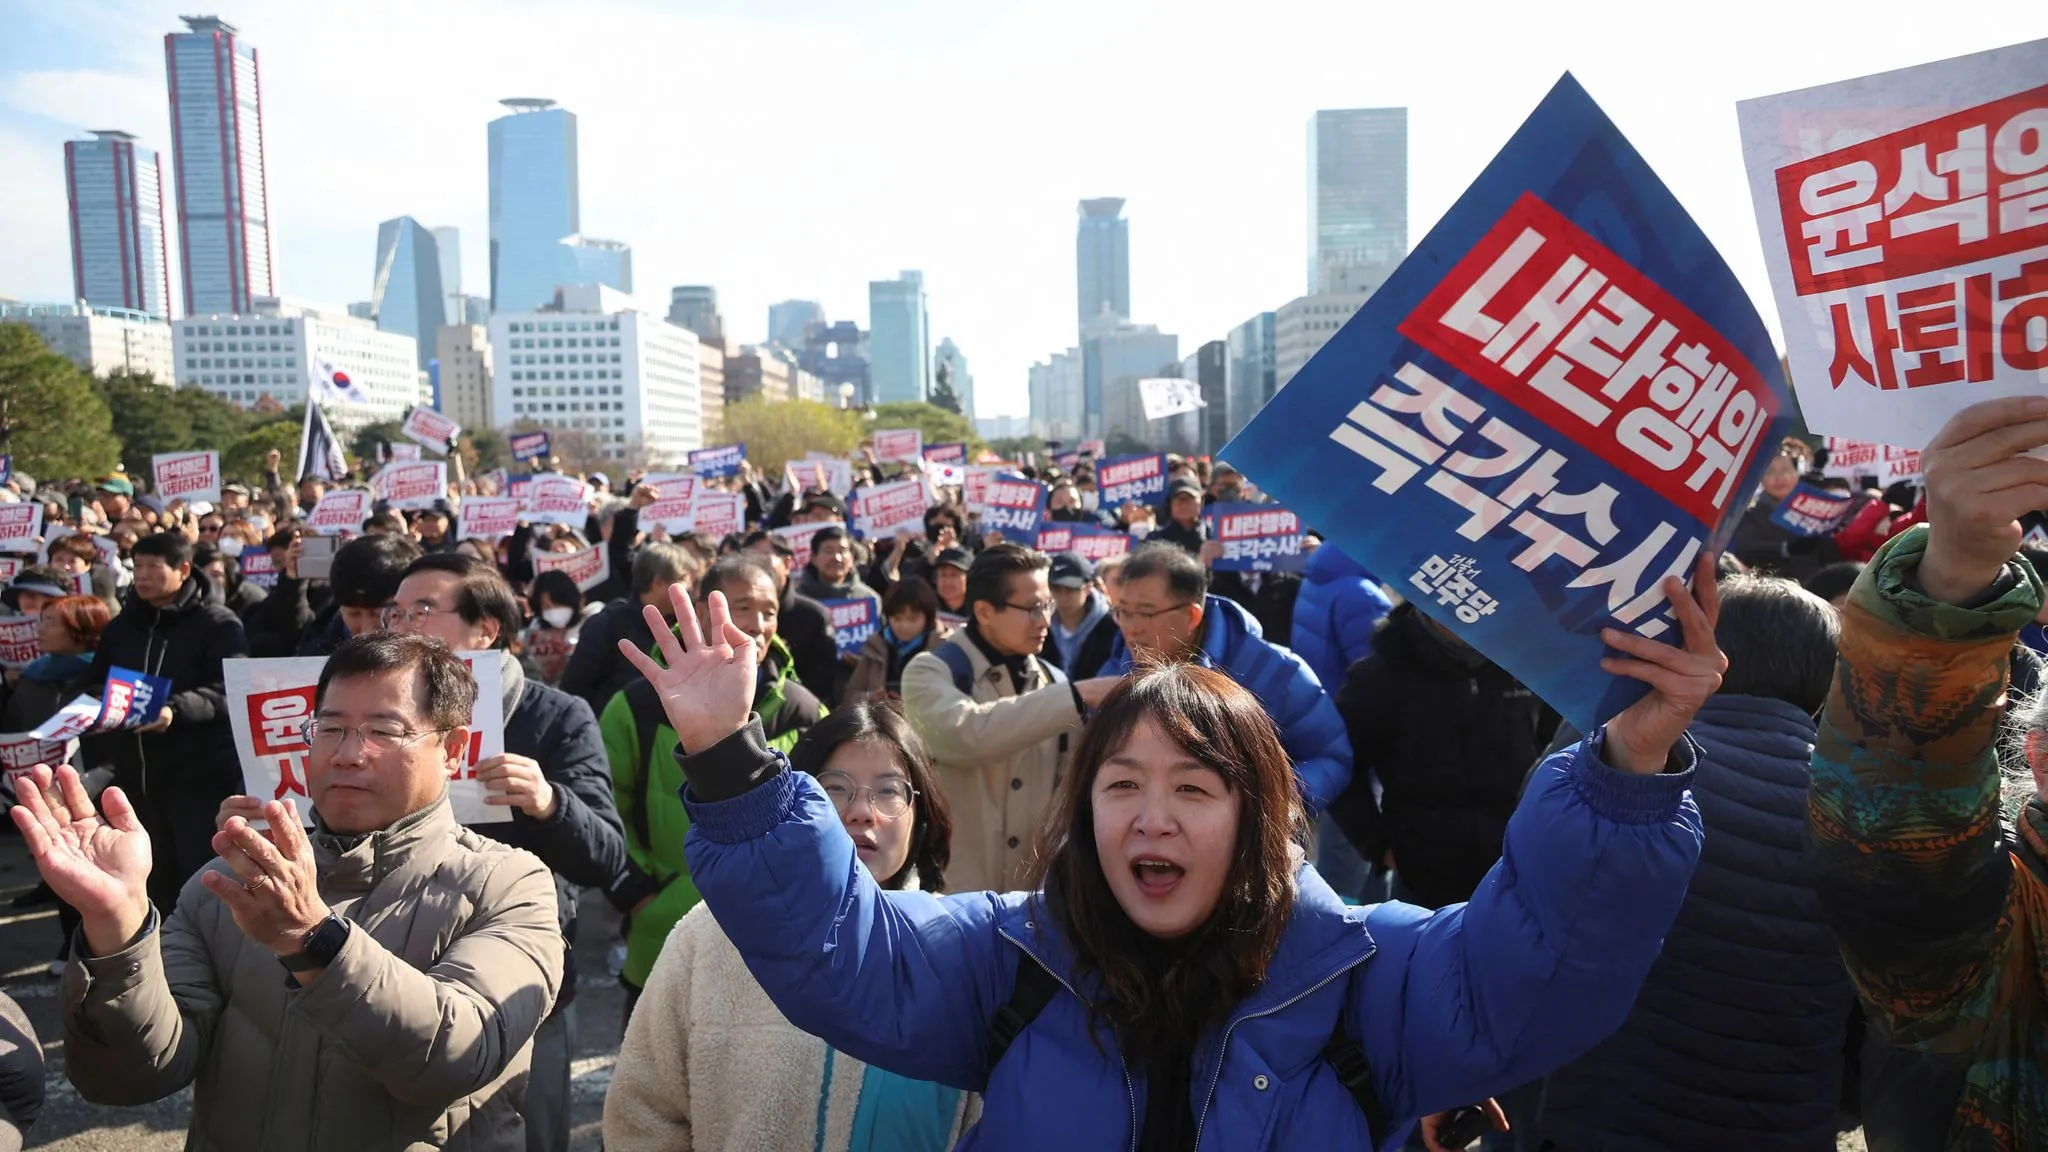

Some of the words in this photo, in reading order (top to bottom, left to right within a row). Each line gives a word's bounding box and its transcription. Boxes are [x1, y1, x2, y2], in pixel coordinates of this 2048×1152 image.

[1439, 227, 1768, 510] 내란행위
[1329, 361, 1702, 638] 즉각수사!
[1222, 511, 1297, 537] 내란행위
[1223, 535, 1303, 561] 즉각수사!
[1448, 554, 1482, 580] 더불어
[1408, 554, 1499, 623] 민주당
